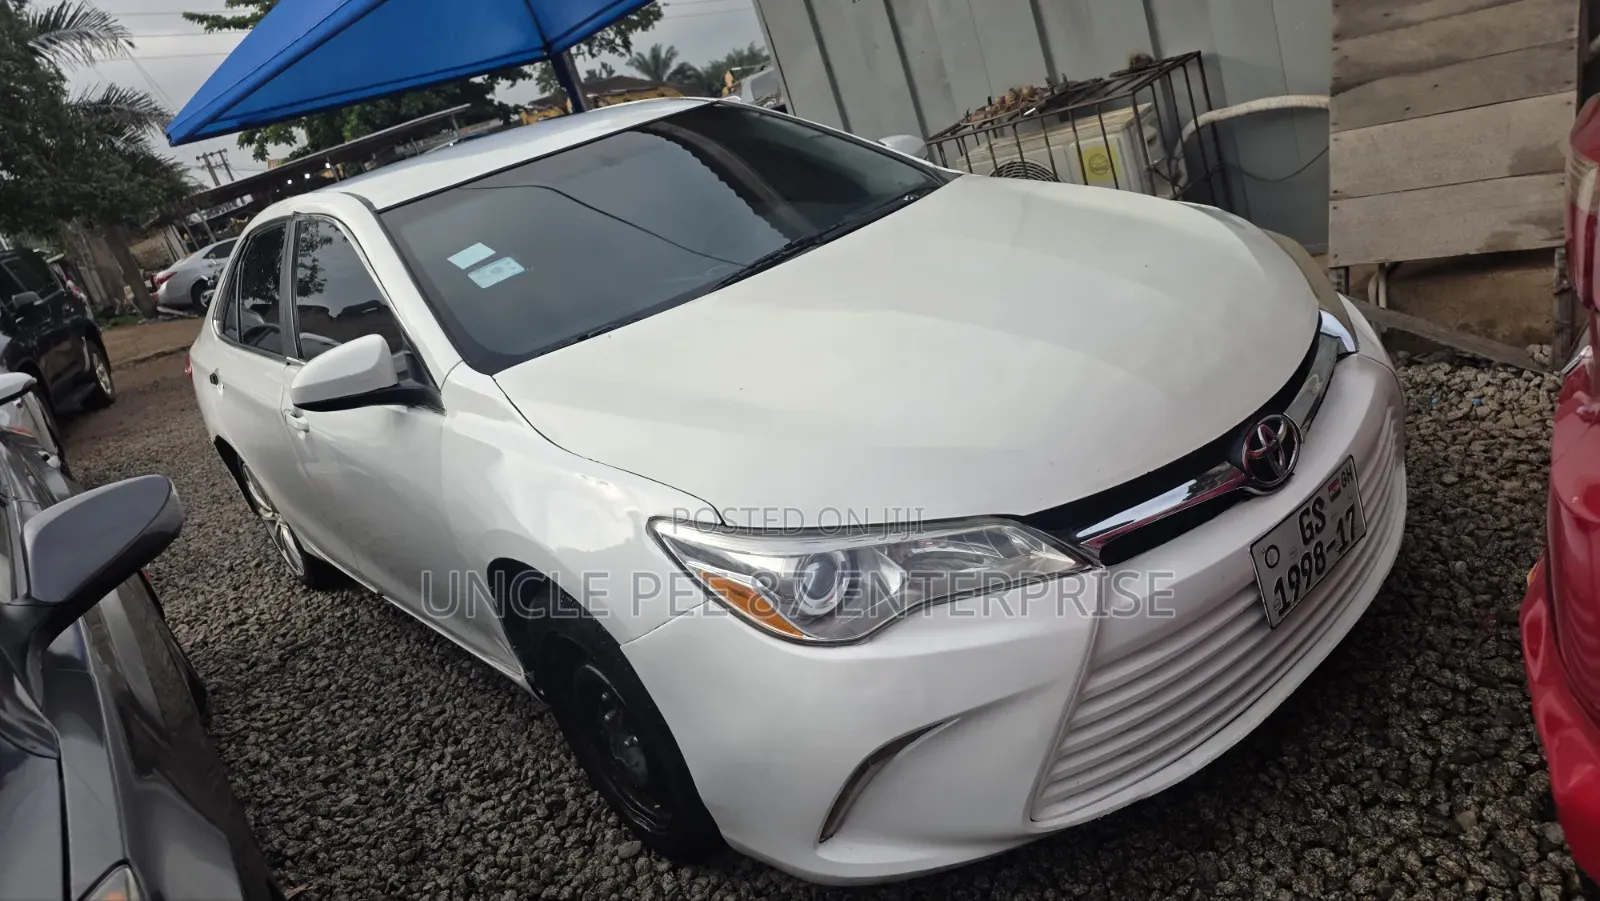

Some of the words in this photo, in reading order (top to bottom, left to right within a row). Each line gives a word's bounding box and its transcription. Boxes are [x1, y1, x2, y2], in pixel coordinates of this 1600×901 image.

[1340, 464, 1354, 488] GH
[1298, 496, 1326, 546] GS
[1273, 503, 1356, 617] 1998-17
